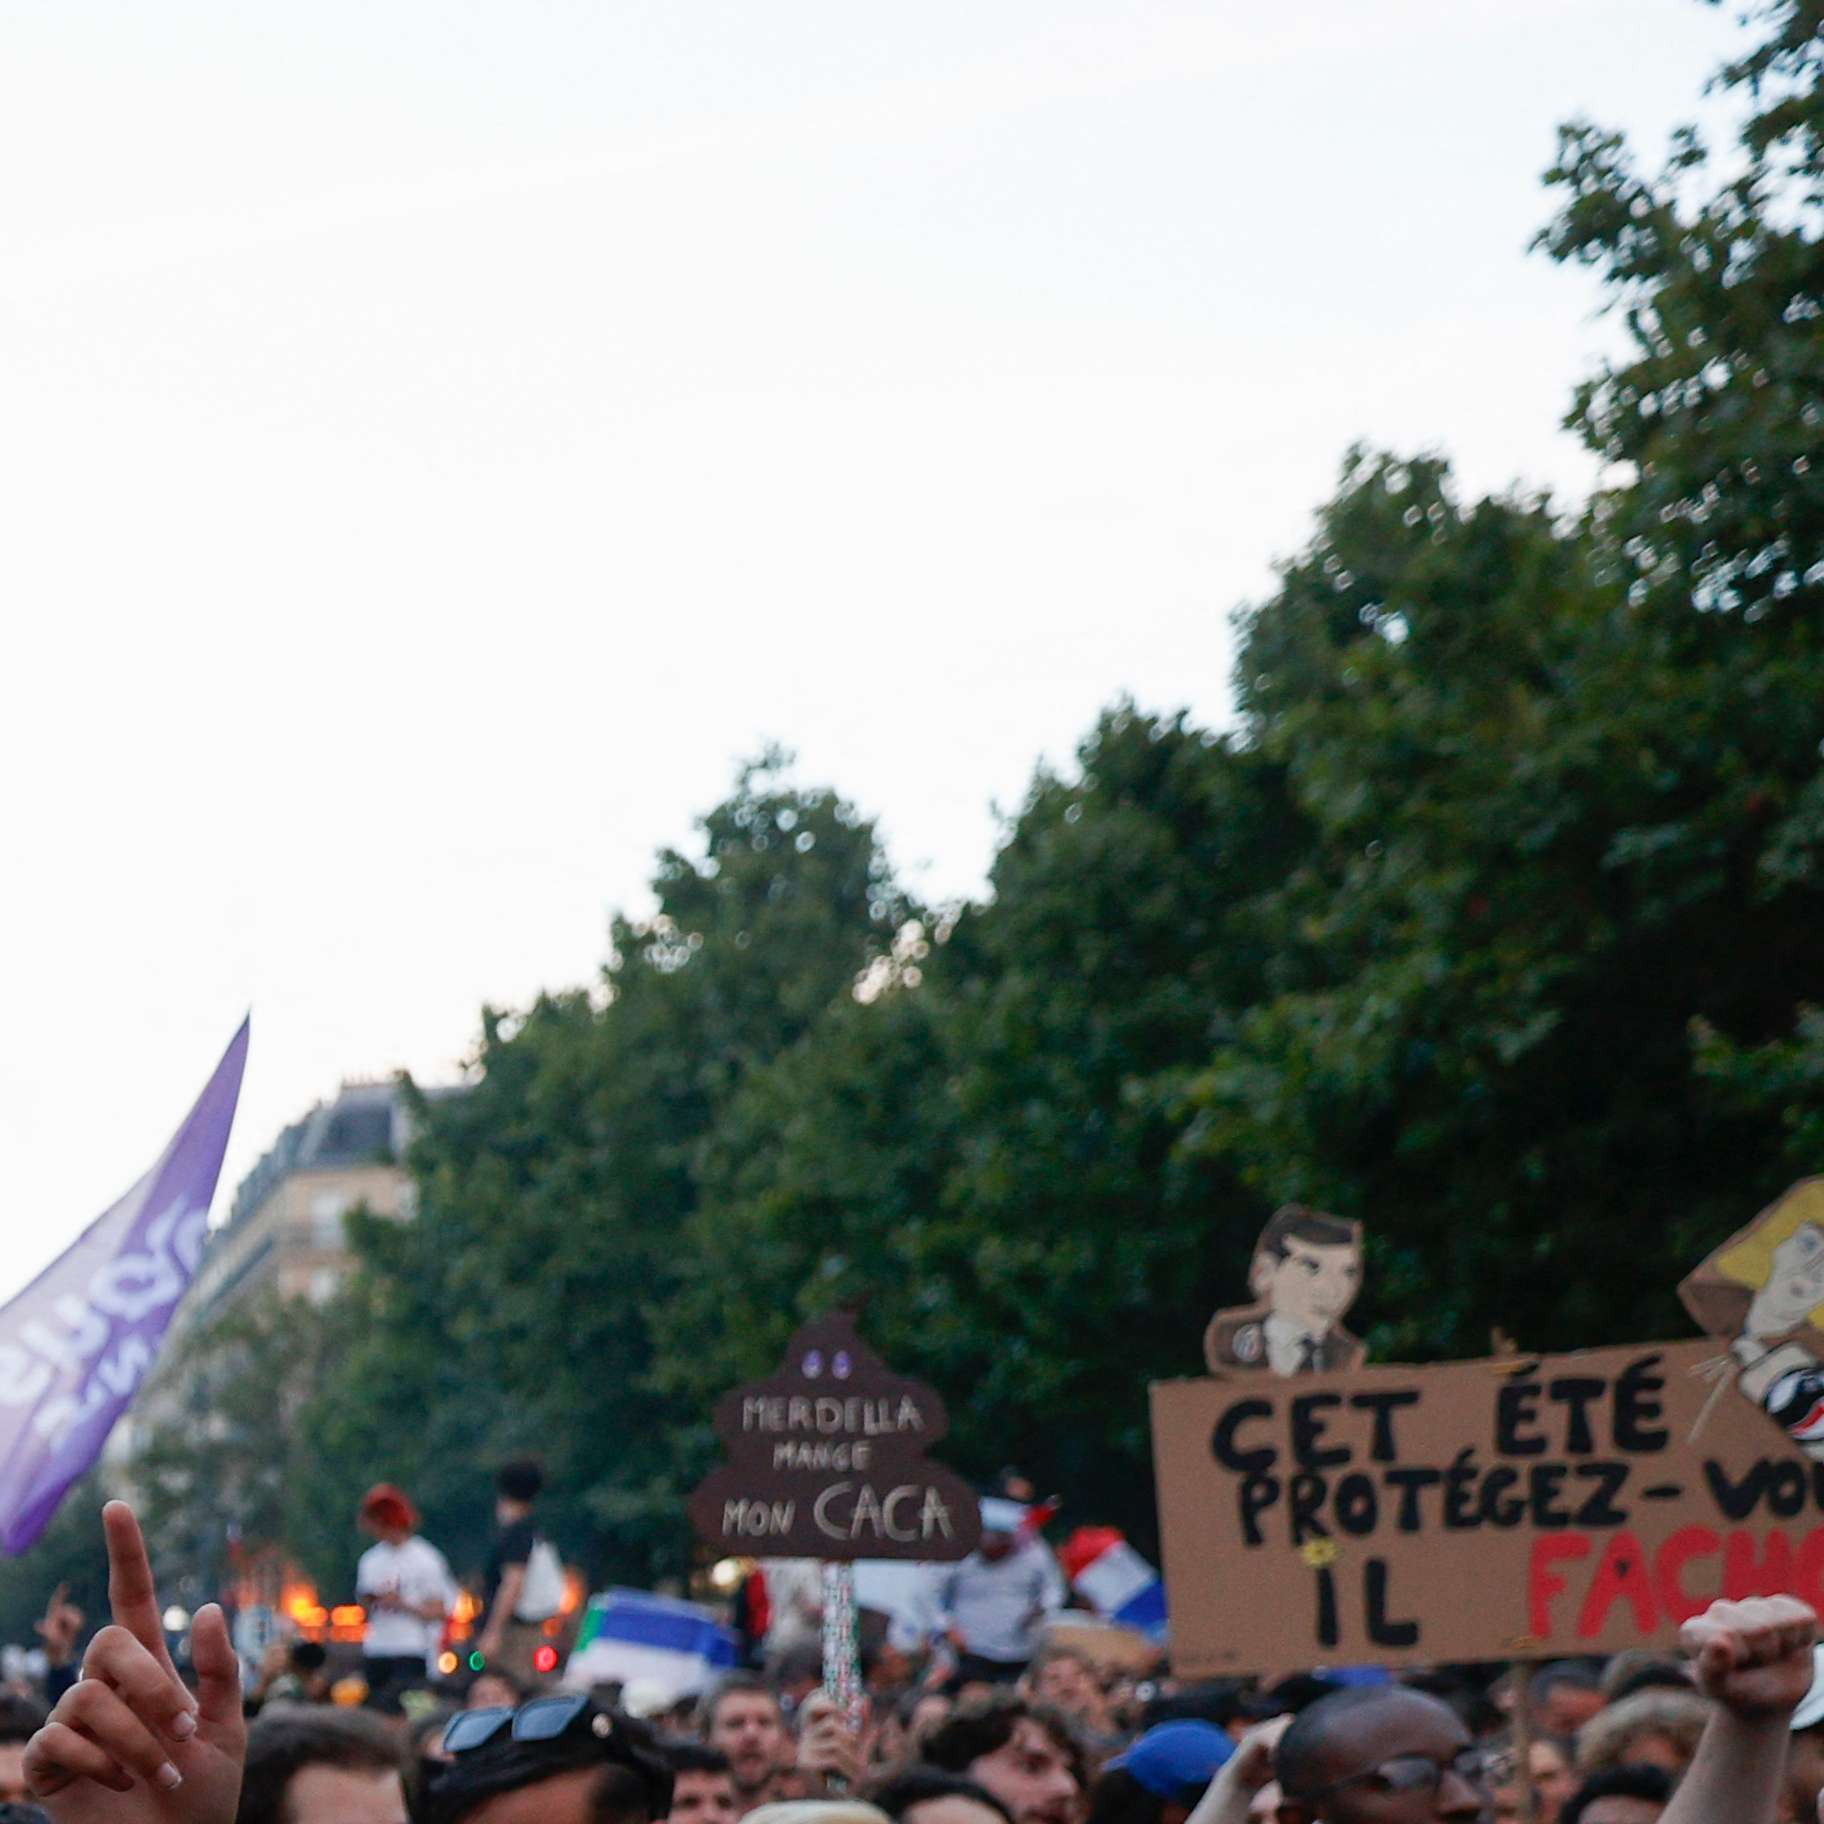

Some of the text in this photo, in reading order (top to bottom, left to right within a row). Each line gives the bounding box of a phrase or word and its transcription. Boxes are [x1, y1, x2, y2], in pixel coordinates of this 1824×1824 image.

[743, 1395, 926, 1436] MERDELLA
[1212, 1354, 1670, 1474] CET ÉTÉ
[773, 1439, 872, 1472] MANGE
[722, 1481, 953, 1542] MON CACA
[1317, 1556, 1420, 1648] IL
